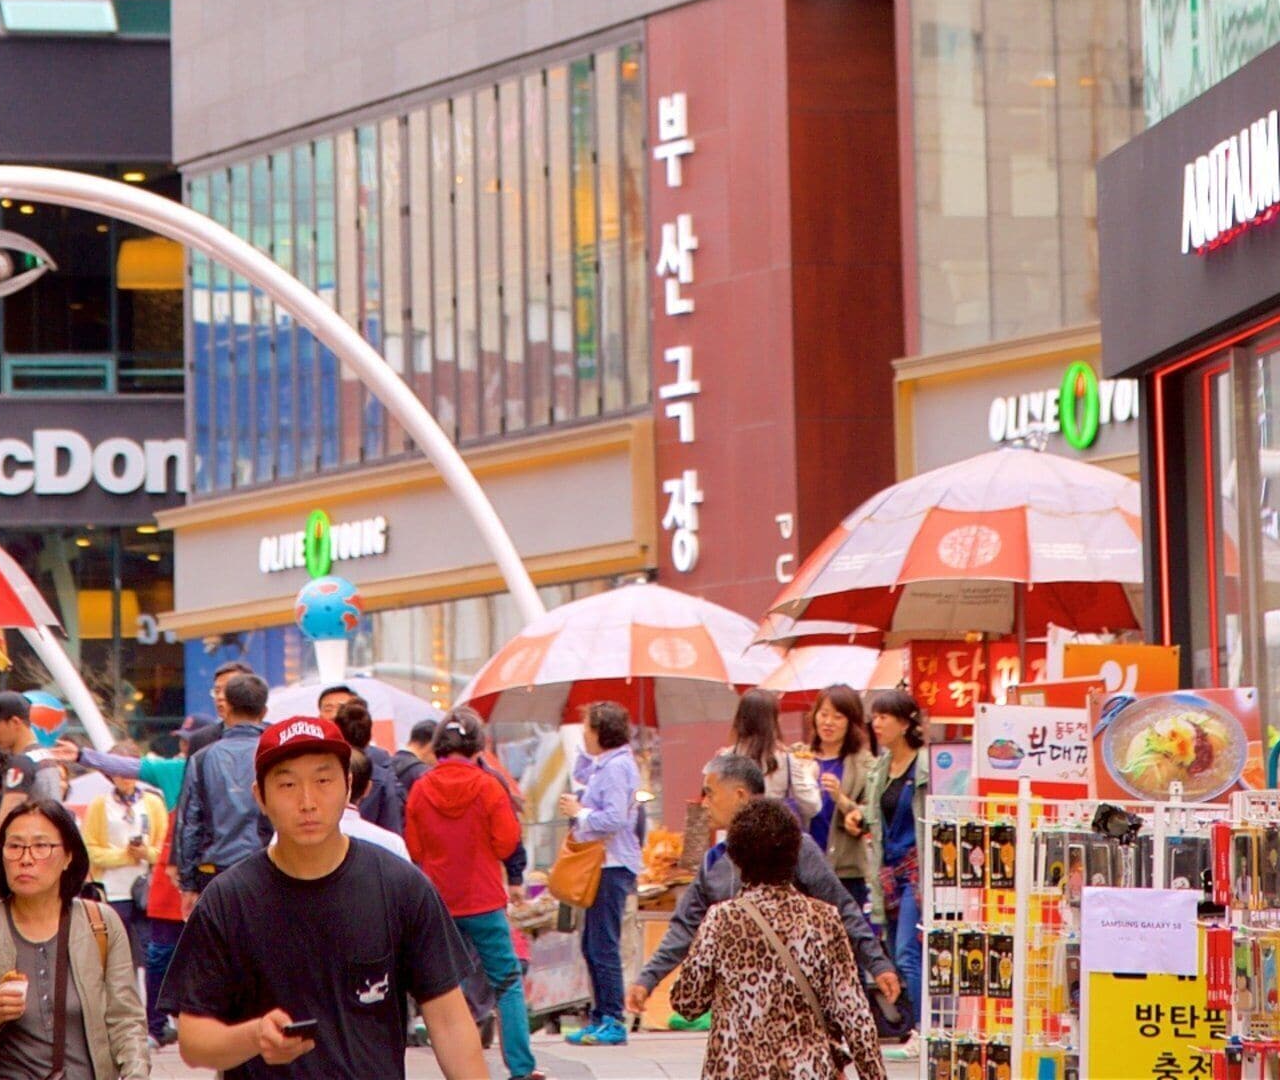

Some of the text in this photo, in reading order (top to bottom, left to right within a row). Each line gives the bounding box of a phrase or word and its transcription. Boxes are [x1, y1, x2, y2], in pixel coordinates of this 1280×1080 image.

[653, 92, 704, 575] 부산극장
[988, 389, 1061, 442] OLIVE
[259, 516, 387, 574] OLIVE YOUNG
[1100, 920, 1139, 929] SAMSUNG
[1140, 921, 1171, 930] GALAXY
